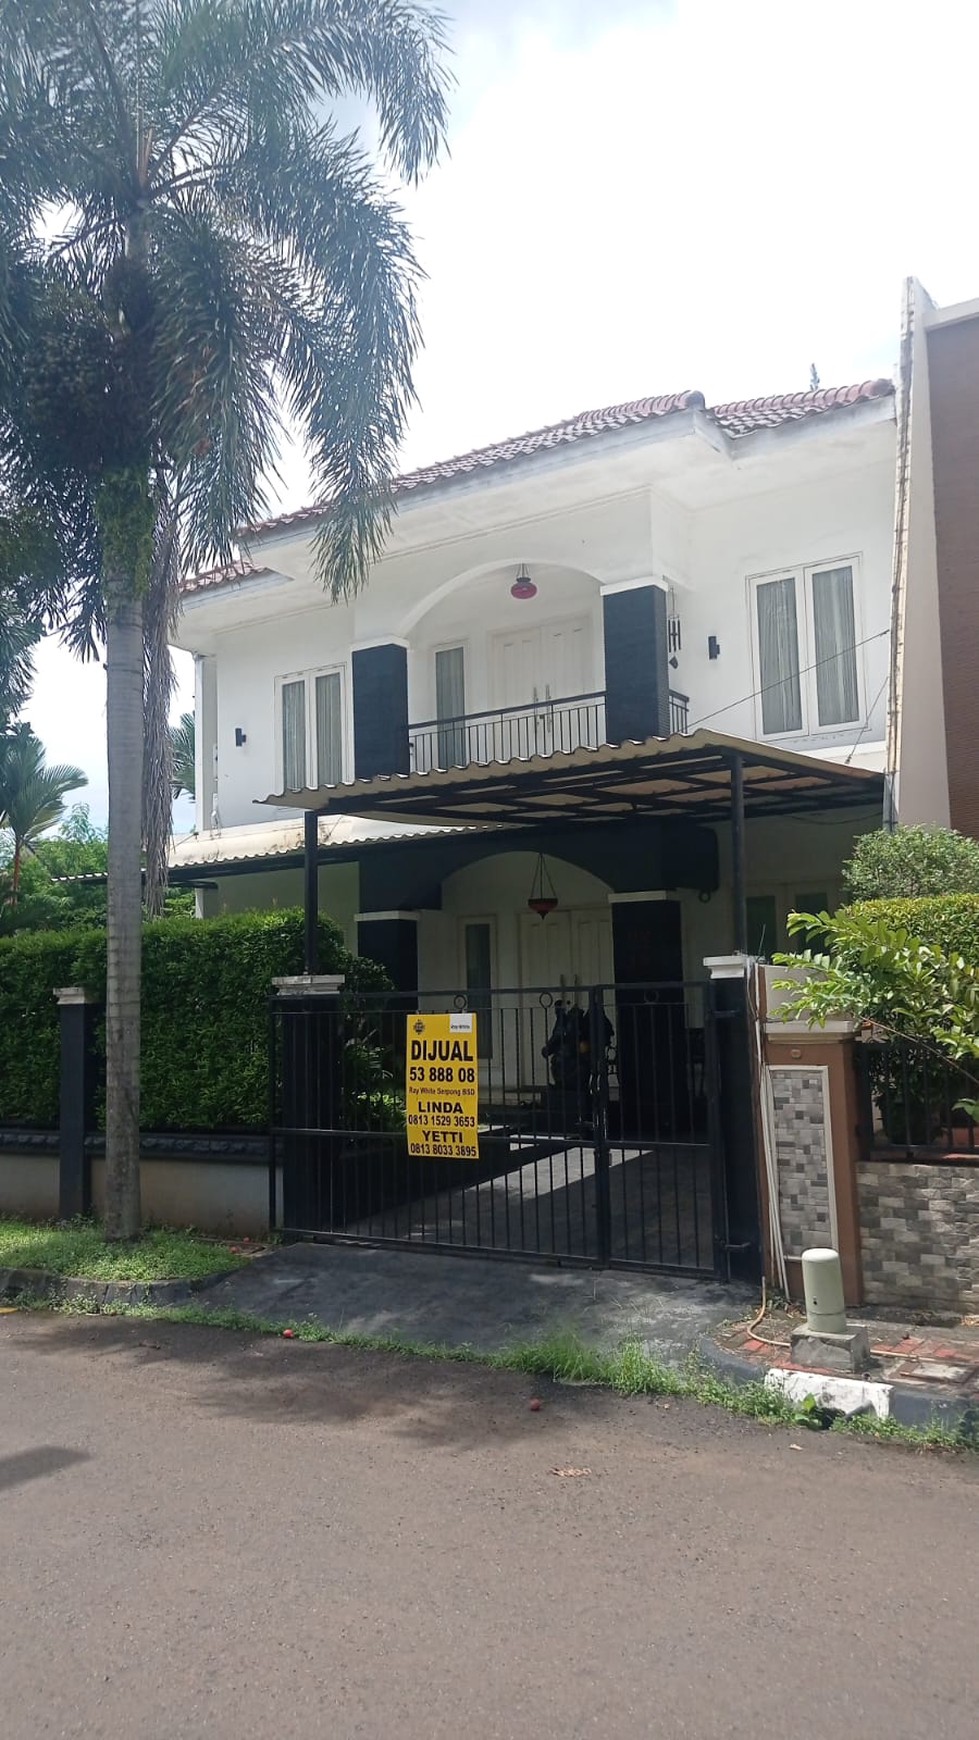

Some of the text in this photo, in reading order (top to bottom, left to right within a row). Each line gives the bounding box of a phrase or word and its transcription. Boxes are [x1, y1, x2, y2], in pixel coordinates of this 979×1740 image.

[411, 1040, 473, 1061] DIJUAL
[409, 1067, 475, 1083] 53 888 08
[418, 1101, 463, 1114] LINDA
[408, 1114, 475, 1127] 0813 1529 3653
[422, 1130, 463, 1143] YETTI
[410, 1143, 430, 1154] 0813
[433, 1144, 453, 1155] 8033
